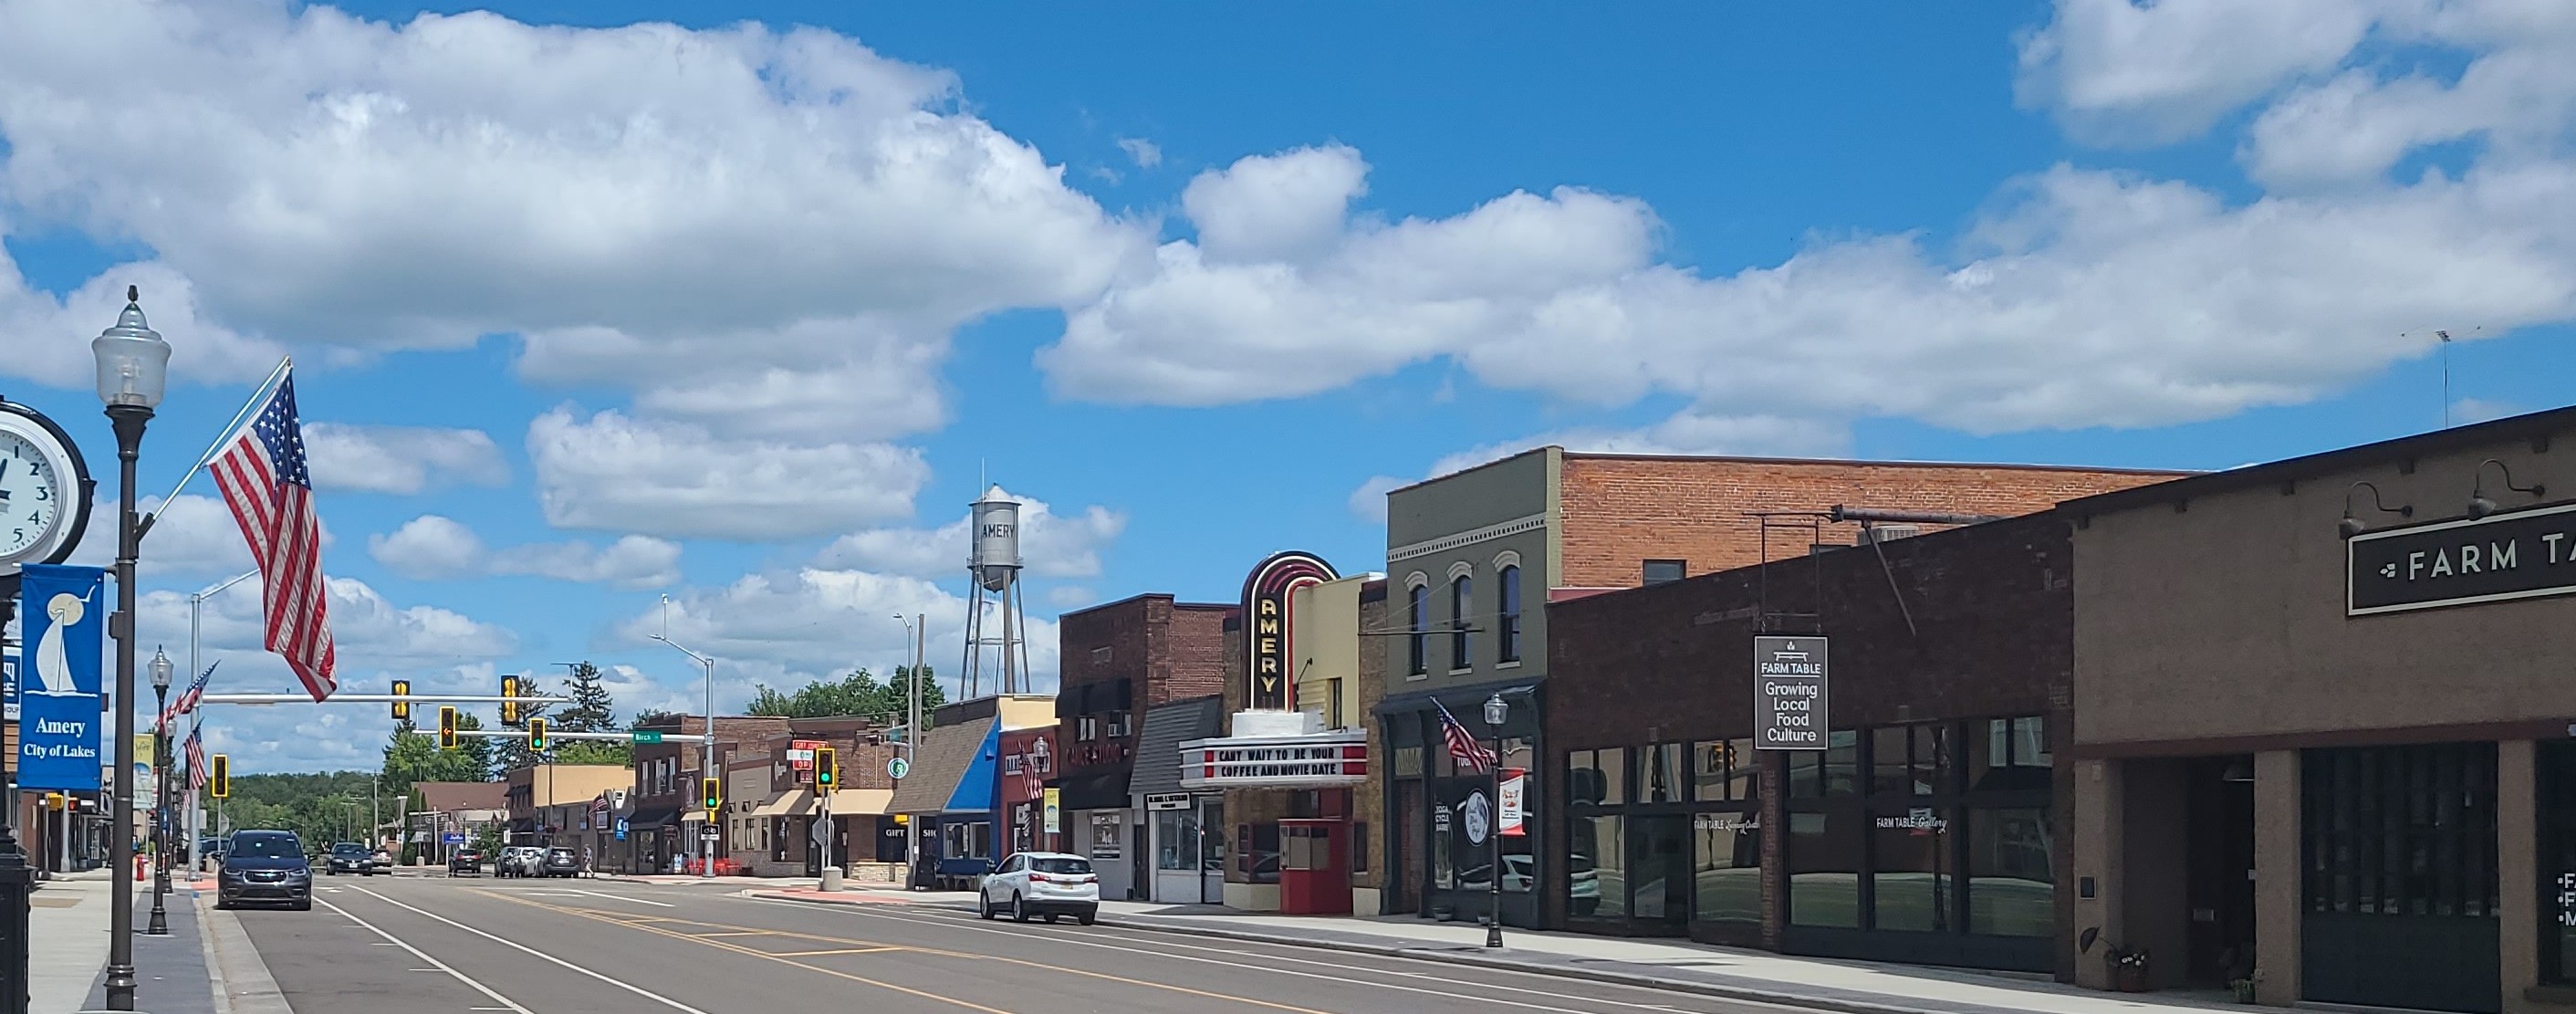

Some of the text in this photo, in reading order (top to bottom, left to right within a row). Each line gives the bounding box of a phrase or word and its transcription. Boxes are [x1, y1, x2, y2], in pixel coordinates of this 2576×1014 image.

[15, 445, 18, 458] 1
[29, 462, 39, 476] 2
[36, 486, 48, 500] 3
[27, 509, 40, 525] 4
[13, 528, 23, 543] 5
[983, 524, 1015, 538] AMERY
[2409, 538, 2517, 580] FARM
[1260, 599, 1278, 693] AMERY
[1761, 663, 1821, 674] FARM TABLE
[1765, 682, 1818, 699] Growing
[1773, 697, 1809, 711] Local
[1776, 713, 1809, 727] Food
[36, 717, 86, 738] Amery
[1767, 728, 1817, 741] Culture
[635, 733, 652, 741] Birch
[24, 744, 96, 759] City of Lakes
[1219, 747, 1334, 761] CANT WAIT TO BE YOUR
[1221, 763, 1336, 777] COFFEE AND MOVIE DATE
[1695, 821, 1707, 830] FARM
[1708, 820, 1724, 830] TABLE
[1876, 816, 1947, 834] FARM TABLE Gallery
[885, 829, 904, 837] GIFT
